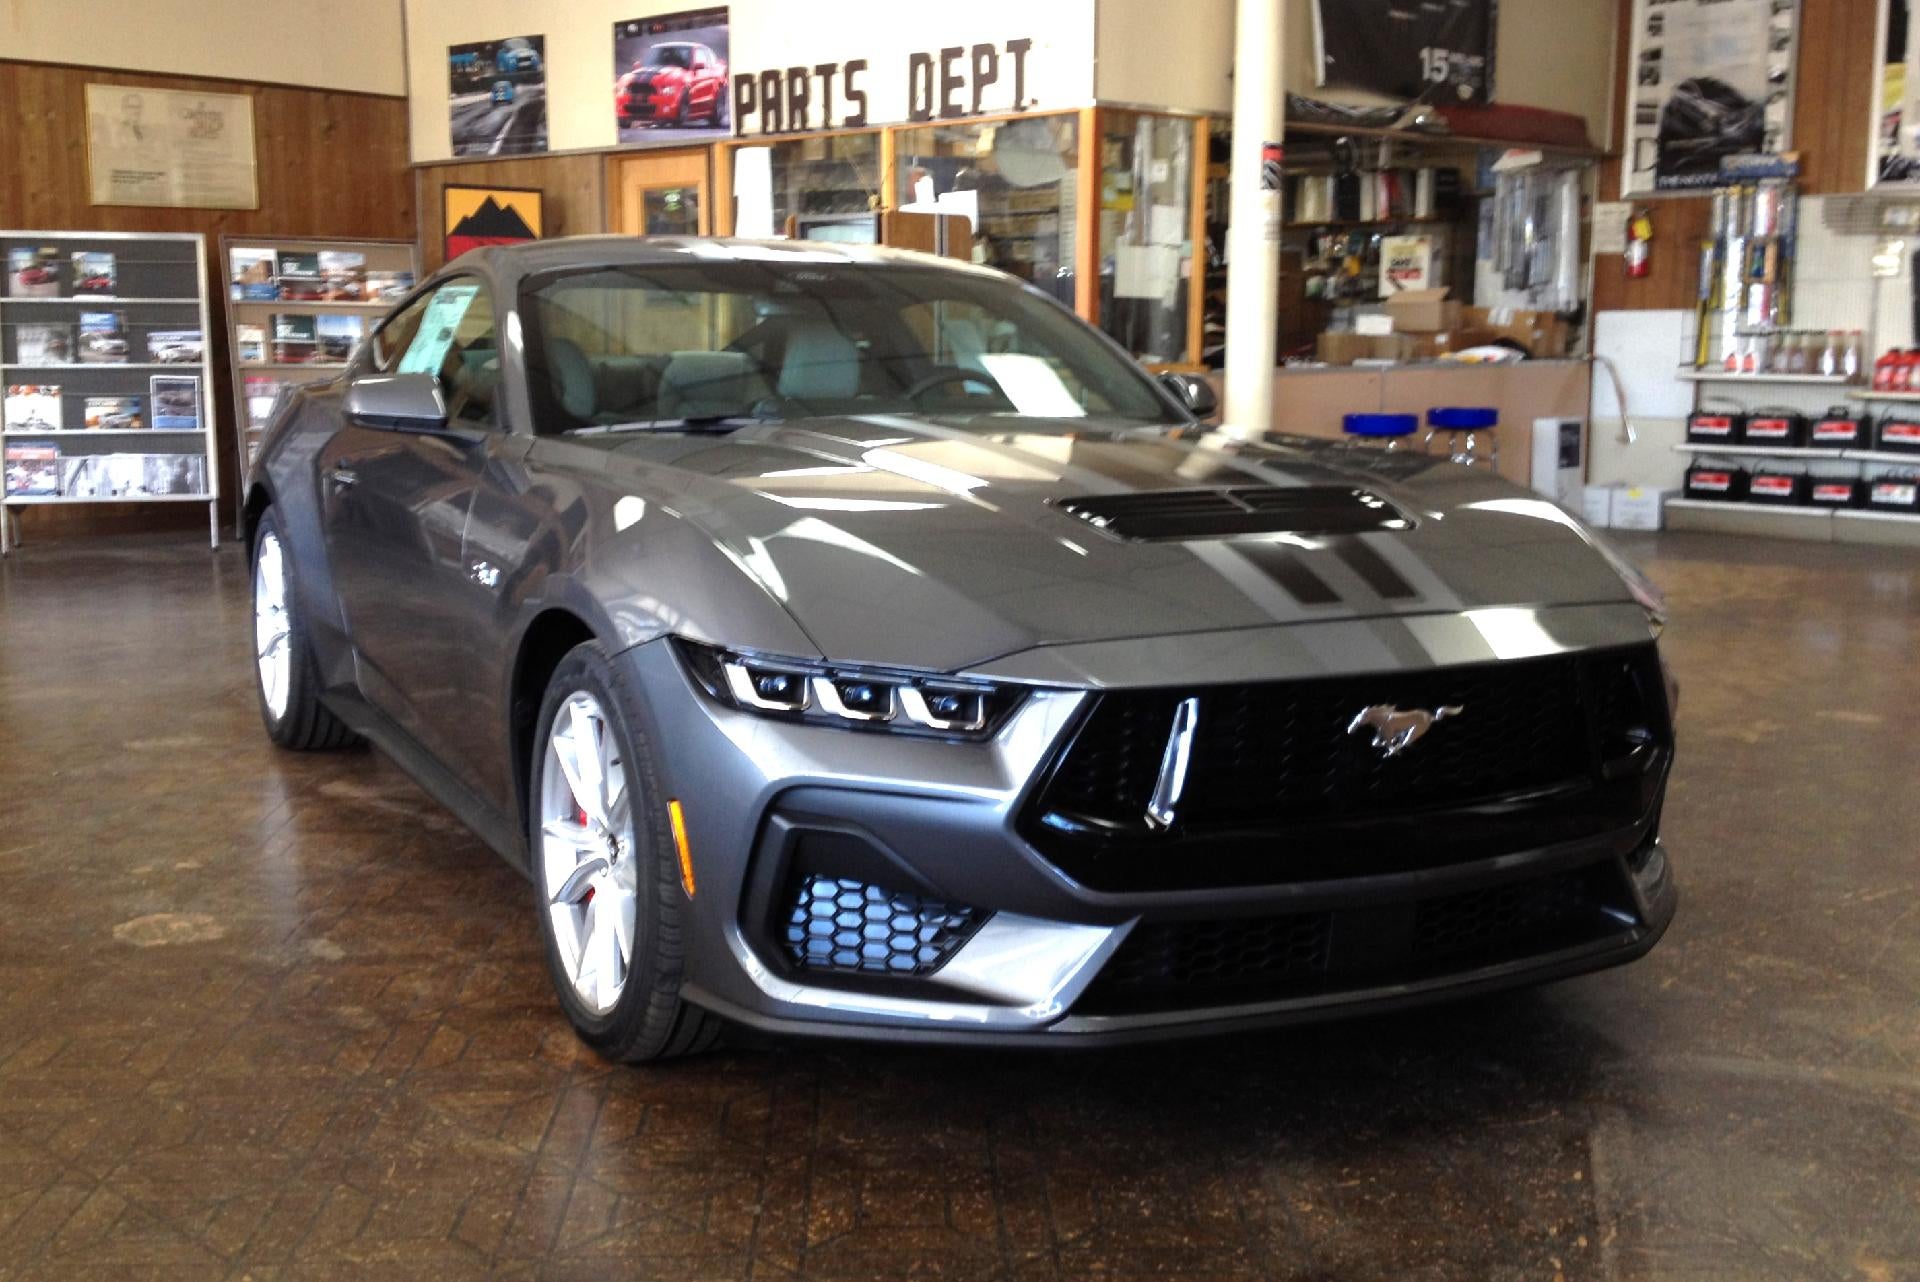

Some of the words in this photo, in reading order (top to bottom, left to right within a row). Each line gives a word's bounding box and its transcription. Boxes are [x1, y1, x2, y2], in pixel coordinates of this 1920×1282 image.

[734, 59, 868, 136] PARTS
[909, 38, 1038, 122] DEPT.
[1420, 46, 1450, 83] 15
